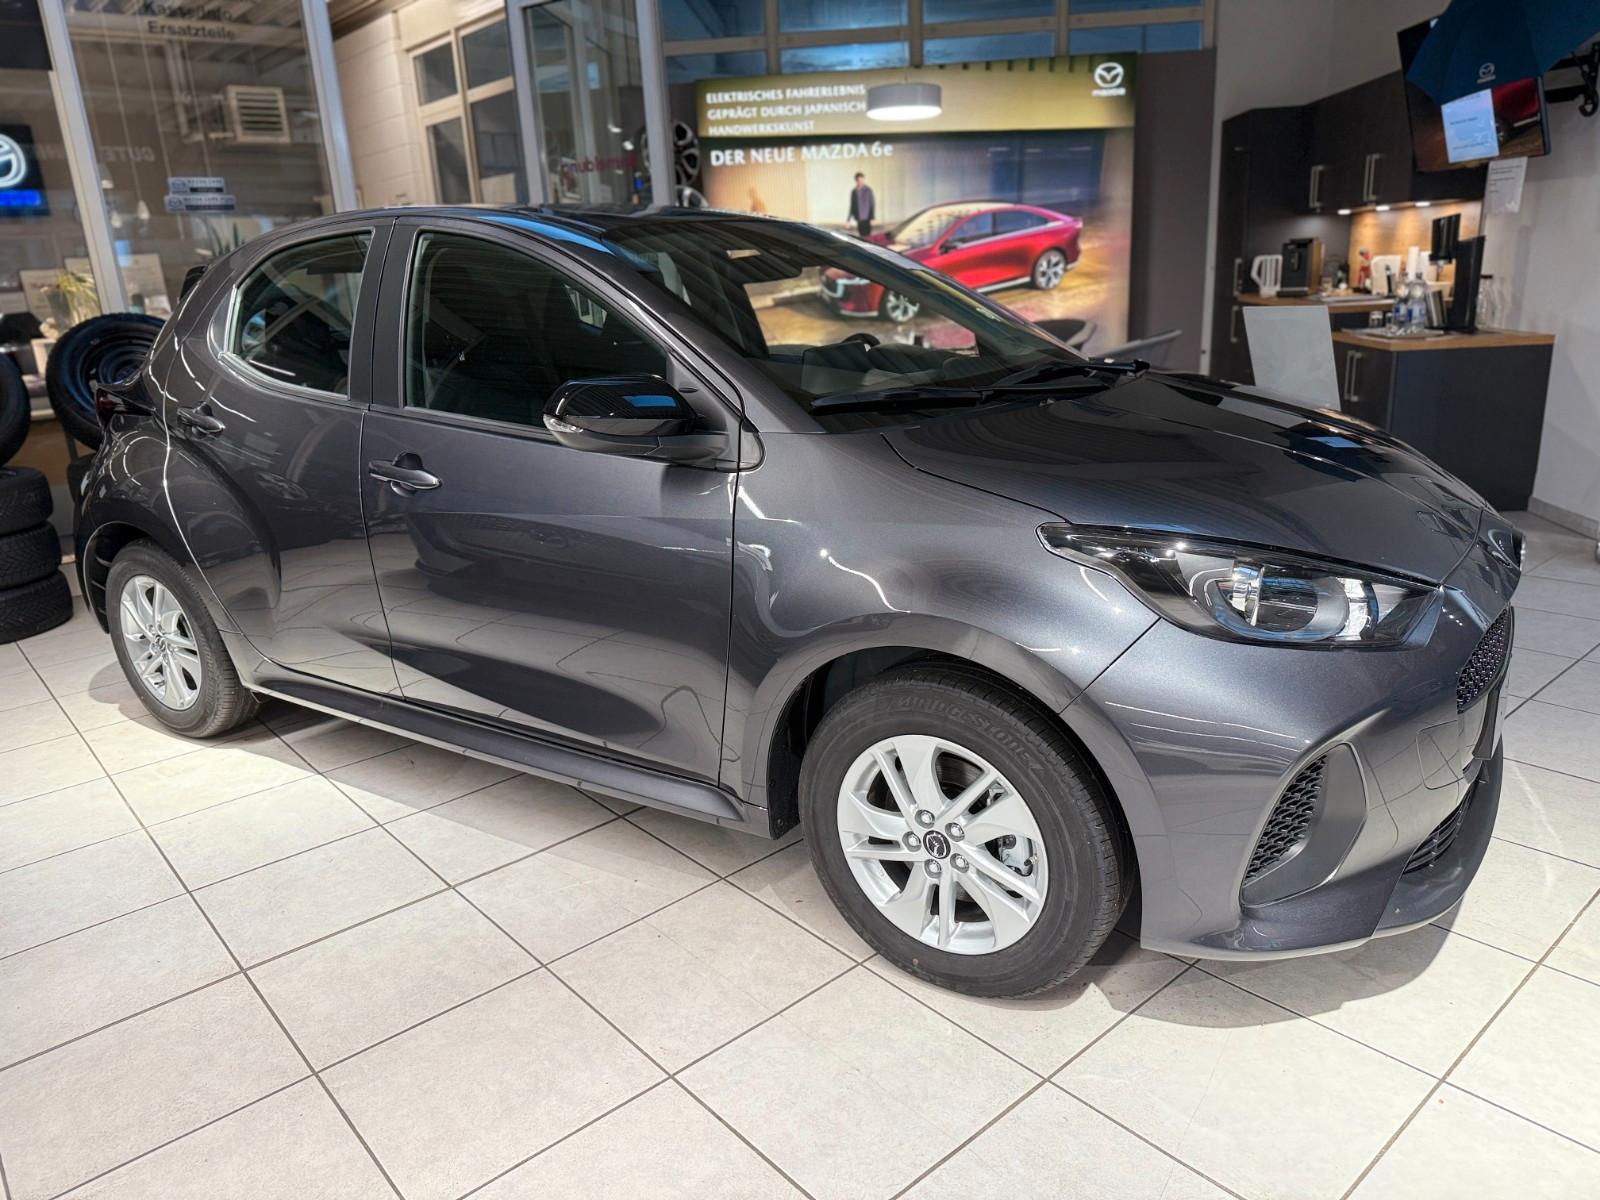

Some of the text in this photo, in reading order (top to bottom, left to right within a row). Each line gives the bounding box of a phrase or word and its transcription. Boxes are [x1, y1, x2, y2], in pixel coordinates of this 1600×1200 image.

[147, 20, 236, 40] Ersatzteile
[706, 84, 866, 104] ELEKTRISCHES FAHRERLEBNIS
[707, 101, 867, 121] GEPRÄGT DURCH JAPANISCH
[708, 120, 816, 137] HANDWERKSKUNST
[710, 141, 894, 166] DER NEUE MAZDA 6e
